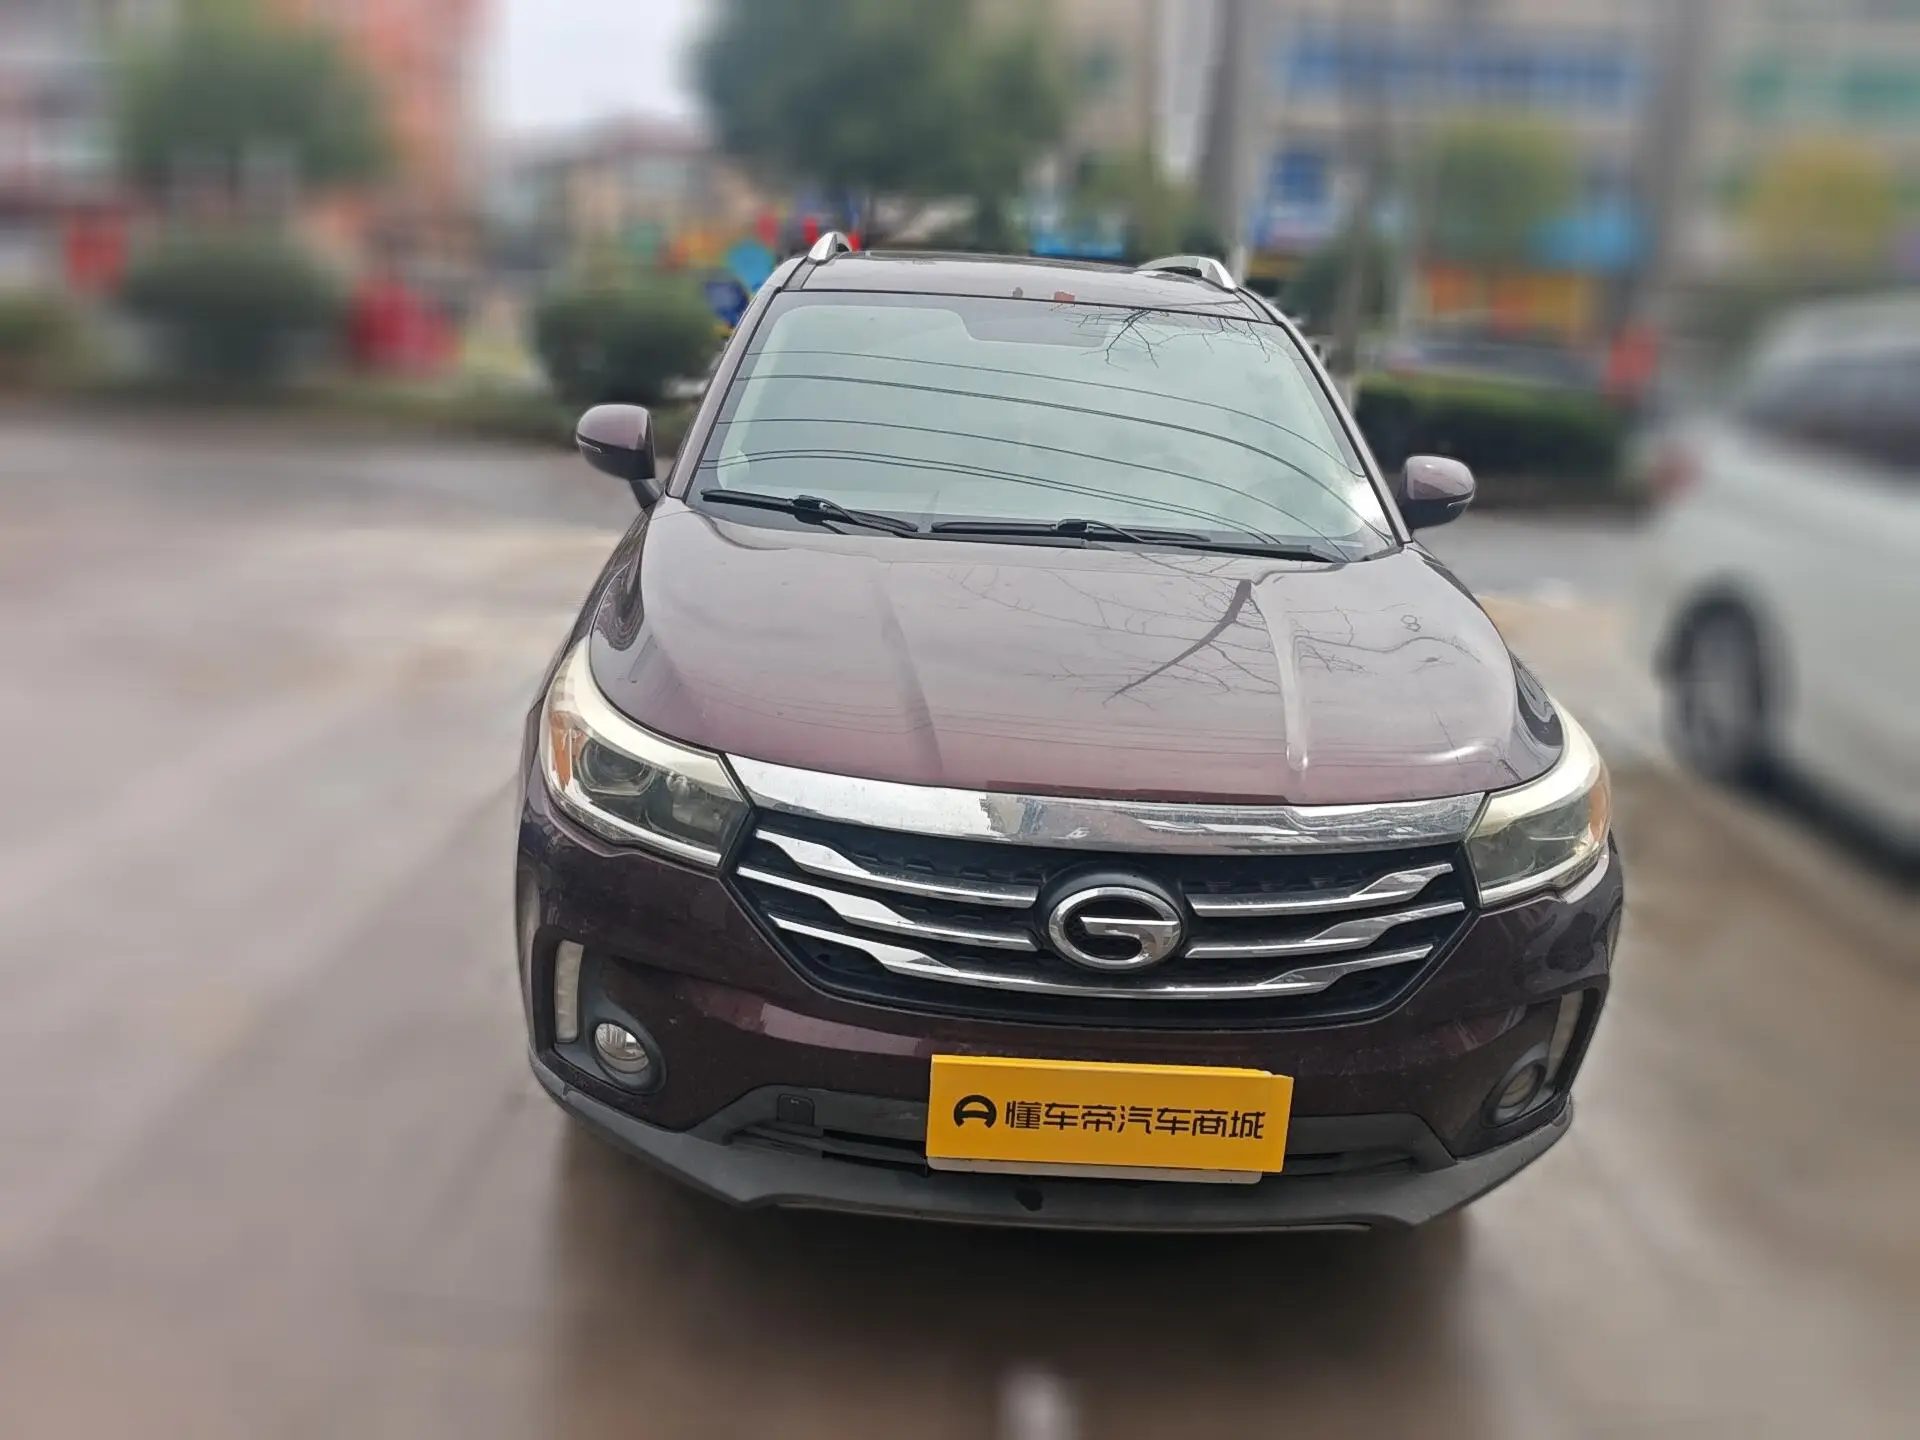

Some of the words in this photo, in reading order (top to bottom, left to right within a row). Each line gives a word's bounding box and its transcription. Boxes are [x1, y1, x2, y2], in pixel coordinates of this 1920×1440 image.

[1004, 1099, 1266, 1140] 懂车帝汽车商城
